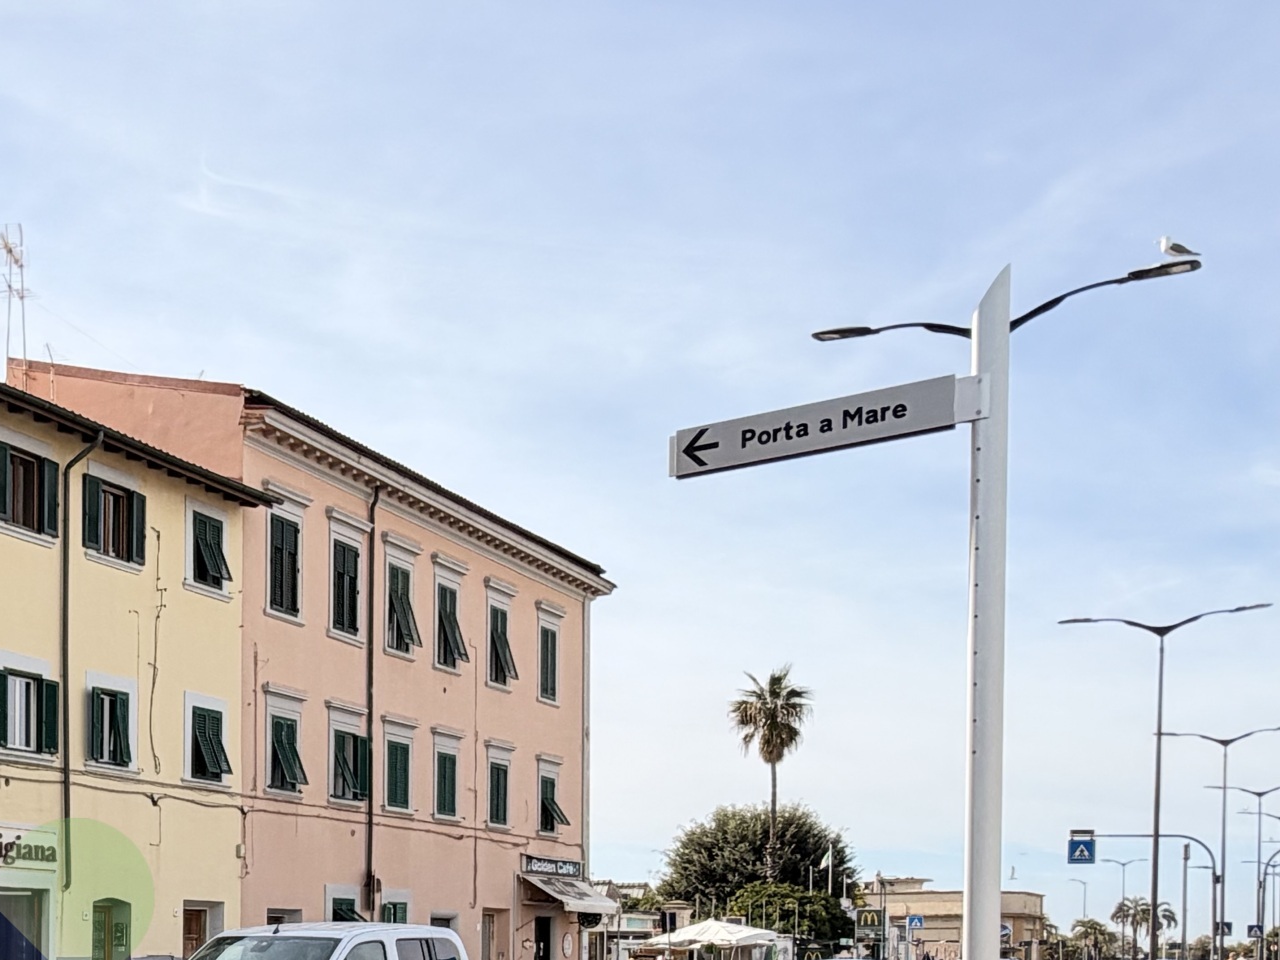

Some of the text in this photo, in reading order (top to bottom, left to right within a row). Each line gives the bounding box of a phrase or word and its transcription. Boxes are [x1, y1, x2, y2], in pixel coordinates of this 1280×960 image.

[741, 403, 908, 449] Porta a Mare
